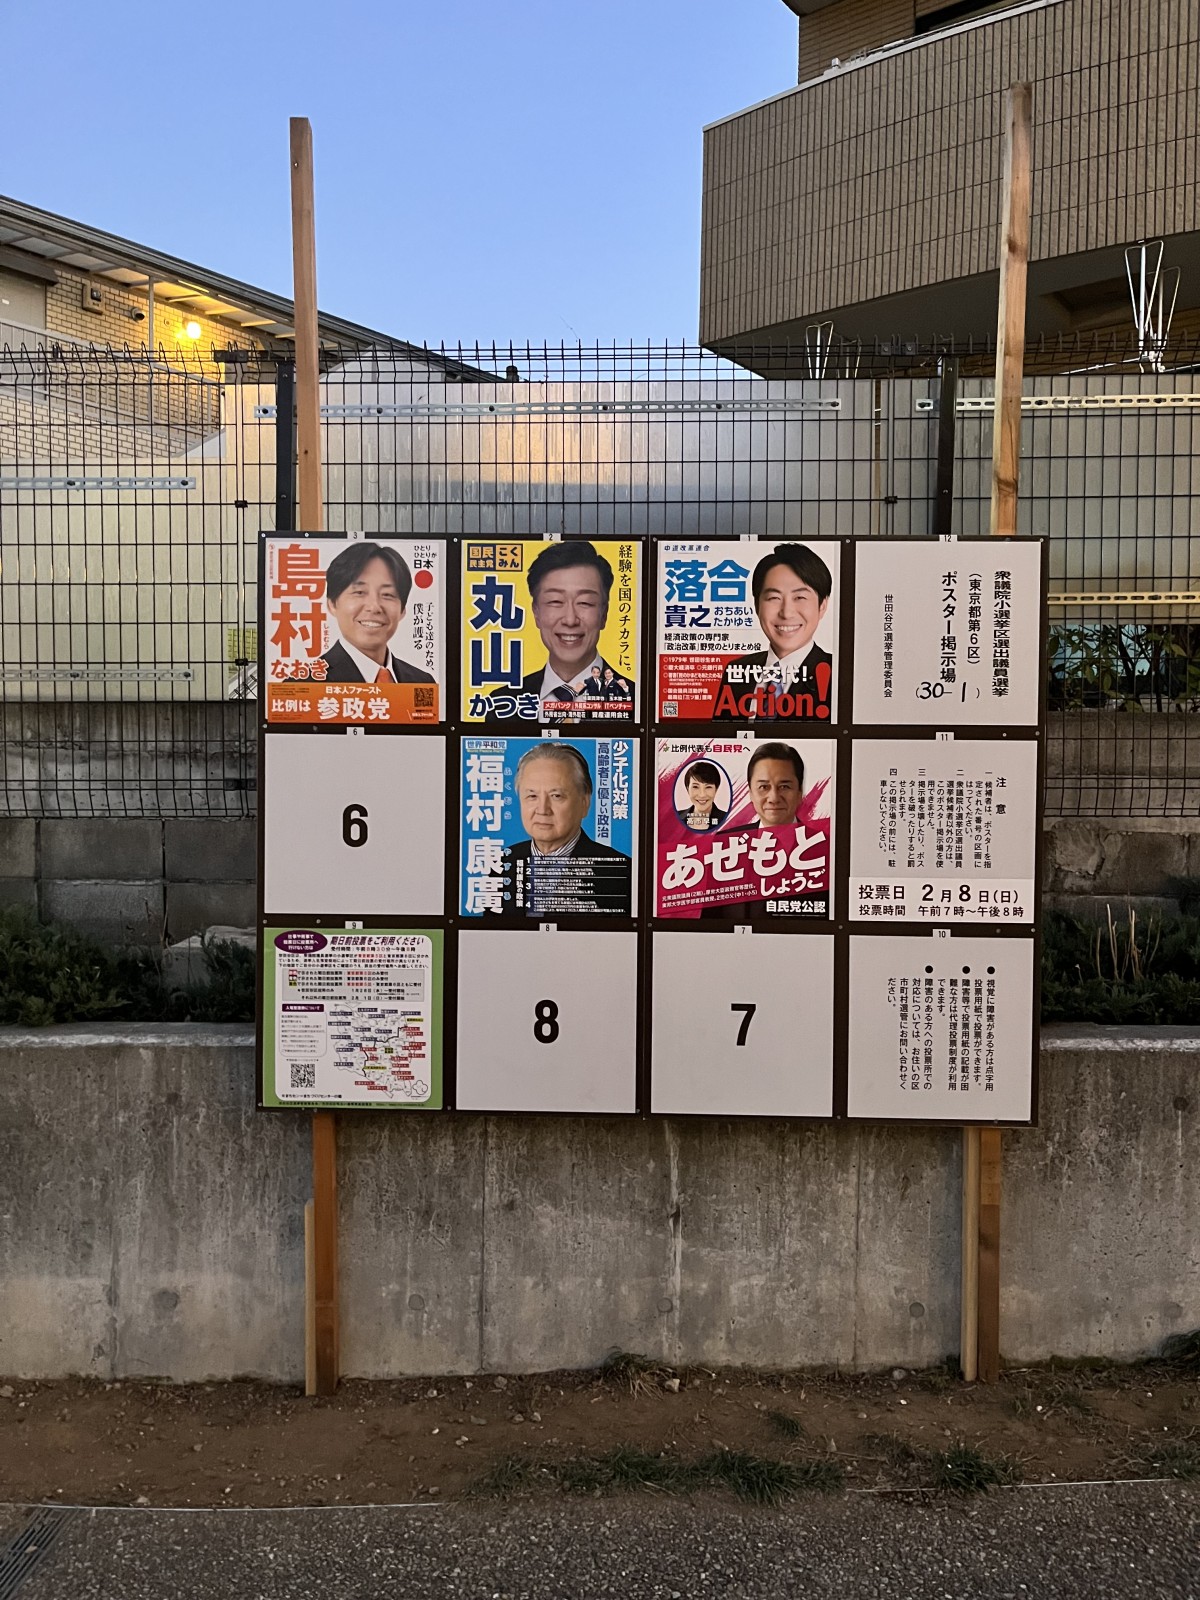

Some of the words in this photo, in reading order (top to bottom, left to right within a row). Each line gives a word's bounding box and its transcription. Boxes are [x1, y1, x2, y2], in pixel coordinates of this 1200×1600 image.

[414, 559, 434, 569] 日本
[469, 547, 494, 557] 国民
[499, 547, 518, 556] こく
[469, 560, 494, 568] 民主党
[498, 558, 520, 568] みん
[271, 544, 328, 658] 島村
[618, 544, 632, 672] 経験を国のチカラに。
[664, 560, 750, 602] 落合
[412, 603, 424, 650] 僕が護る
[426, 602, 435, 671] 子ども達のため、
[469, 576, 524, 687] 丸山
[664, 605, 712, 628] 貴之
[714, 607, 753, 616] おちあい
[664, 633, 729, 641] 経済政策の専門家
[713, 617, 753, 627] たかゆき
[940, 571, 958, 683] ポスター掲示場
[967, 573, 982, 664] （東京都第6区）
[992, 571, 1011, 697] 衆議院小選挙区選出議員選挙
[271, 659, 330, 681] なおき
[664, 643, 761, 651] 「政治改革」野党のとりまとめ役
[884, 594, 893, 697] 世田谷区選挙管理委員会
[325, 686, 382, 695] 日本人ファースト
[715, 662, 831, 719] Action!
[726, 665, 807, 684] 世代交代！
[271, 699, 311, 713] 比例は
[317, 697, 390, 720] 参政党
[469, 694, 539, 718] かつき
[671, 744, 750, 753] 比例代表も自民党へ
[890, 768, 897, 776] 四
[466, 754, 504, 832] 福村
[598, 742, 610, 838] 高齢者に優しい政治
[613, 740, 628, 820] 少子化対策
[927, 780, 935, 830] 用できません。
[996, 777, 1007, 815] 注意
[342, 804, 368, 848] 6
[879, 780, 887, 852] 車しないでください。
[917, 780, 926, 867] 掲示場を壊したり、ポス
[936, 781, 944, 868] このポスター掲示場を使
[946, 780, 954, 864] 選挙候補者以外の方は、
[955, 781, 964, 868] 衆議院小選挙区選出議員
[965, 781, 974, 838] はってください。
[974, 781, 983, 868] 定された番号の区画に
[984, 782, 993, 868] 候補者は、ポスターを指
[465, 837, 504, 914] 康廣
[662, 826, 826, 889] あぜもと
[760, 869, 826, 896] しょうご
[766, 900, 826, 913] 自民党公認
[858, 885, 905, 900] 投票日
[859, 904, 906, 916] 投票時間
[918, 906, 1024, 917] 午前7時～午後8時
[330, 936, 424, 945] 期日前投票をご利用ください
[888, 978, 896, 1007] ださい。
[937, 979, 946, 1017] できます。
[534, 999, 559, 1044] 8
[730, 1003, 756, 1046] 7
[899, 978, 908, 1090] 市町村選管にお問い合わせく
[912, 978, 921, 1090] 対応については、お住いの区
[924, 978, 933, 1090] 障害のある方への投票所での
[948, 979, 958, 1091] 難な方は代理投票制度が利用
[961, 979, 970, 1091] 障害等で投票用紙の記載が困
[974, 979, 983, 1086] 投票用紙で投票ができます。
[985, 980, 995, 1091] 視覚に障害がある方は点字用
